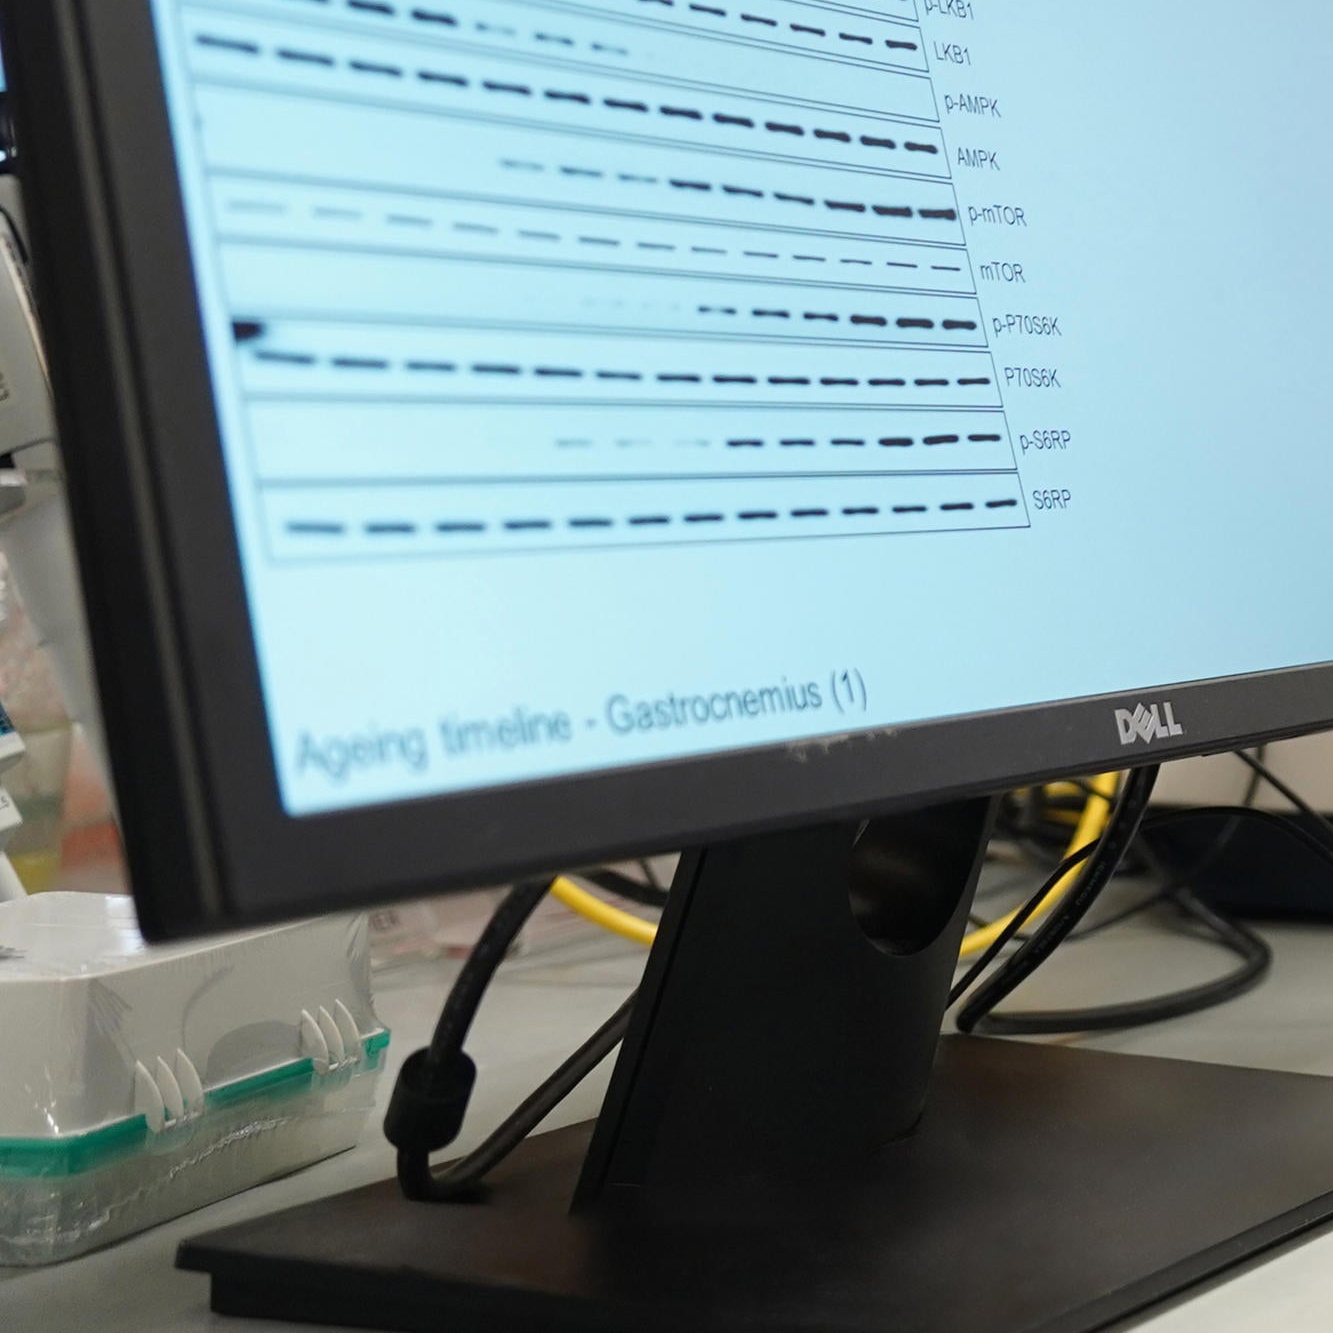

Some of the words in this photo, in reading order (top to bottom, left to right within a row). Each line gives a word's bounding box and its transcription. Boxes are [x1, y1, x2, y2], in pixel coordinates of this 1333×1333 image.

[933, 41, 971, 66] LKB1
[944, 93, 1001, 118] p-AMPK
[957, 147, 1000, 171] AMPK
[968, 204, 1027, 227] p-mTOR
[980, 261, 1026, 283] mTOR
[992, 314, 1062, 338] p-P70S6K
[1004, 367, 1061, 388] P70S6K
[1020, 430, 1071, 455] p-S6RP
[1032, 489, 1071, 510] S6RP
[298, 721, 426, 781] Ageing
[438, 703, 574, 755] timeline
[604, 675, 824, 735] Gastrocnemius
[831, 668, 868, 713] (1)
[1114, 701, 1184, 745] DELL
